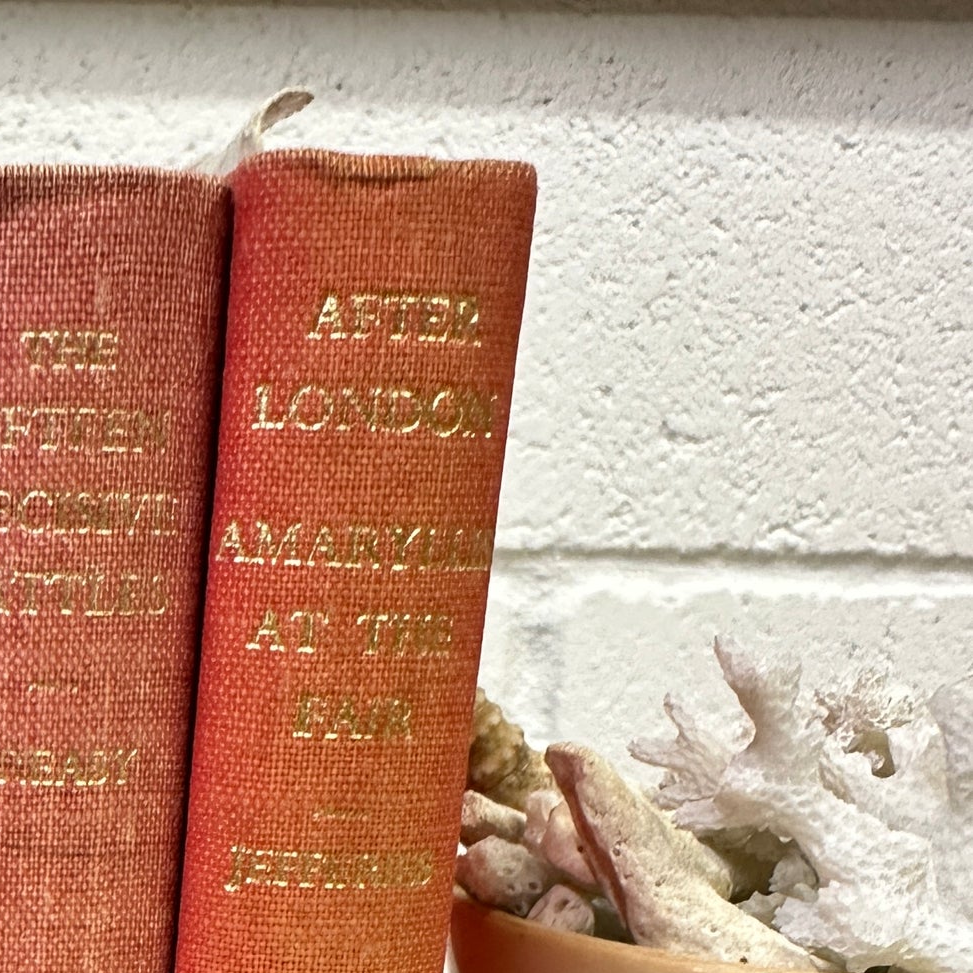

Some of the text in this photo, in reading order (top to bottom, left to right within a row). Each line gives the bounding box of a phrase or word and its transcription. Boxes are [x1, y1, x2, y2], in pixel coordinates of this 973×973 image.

[305, 292, 483, 347] AFTER
[19, 330, 119, 373] THE
[251, 383, 498, 438] LONDON
[244, 610, 455, 658] AT THE
[291, 692, 414, 741] FAIR
